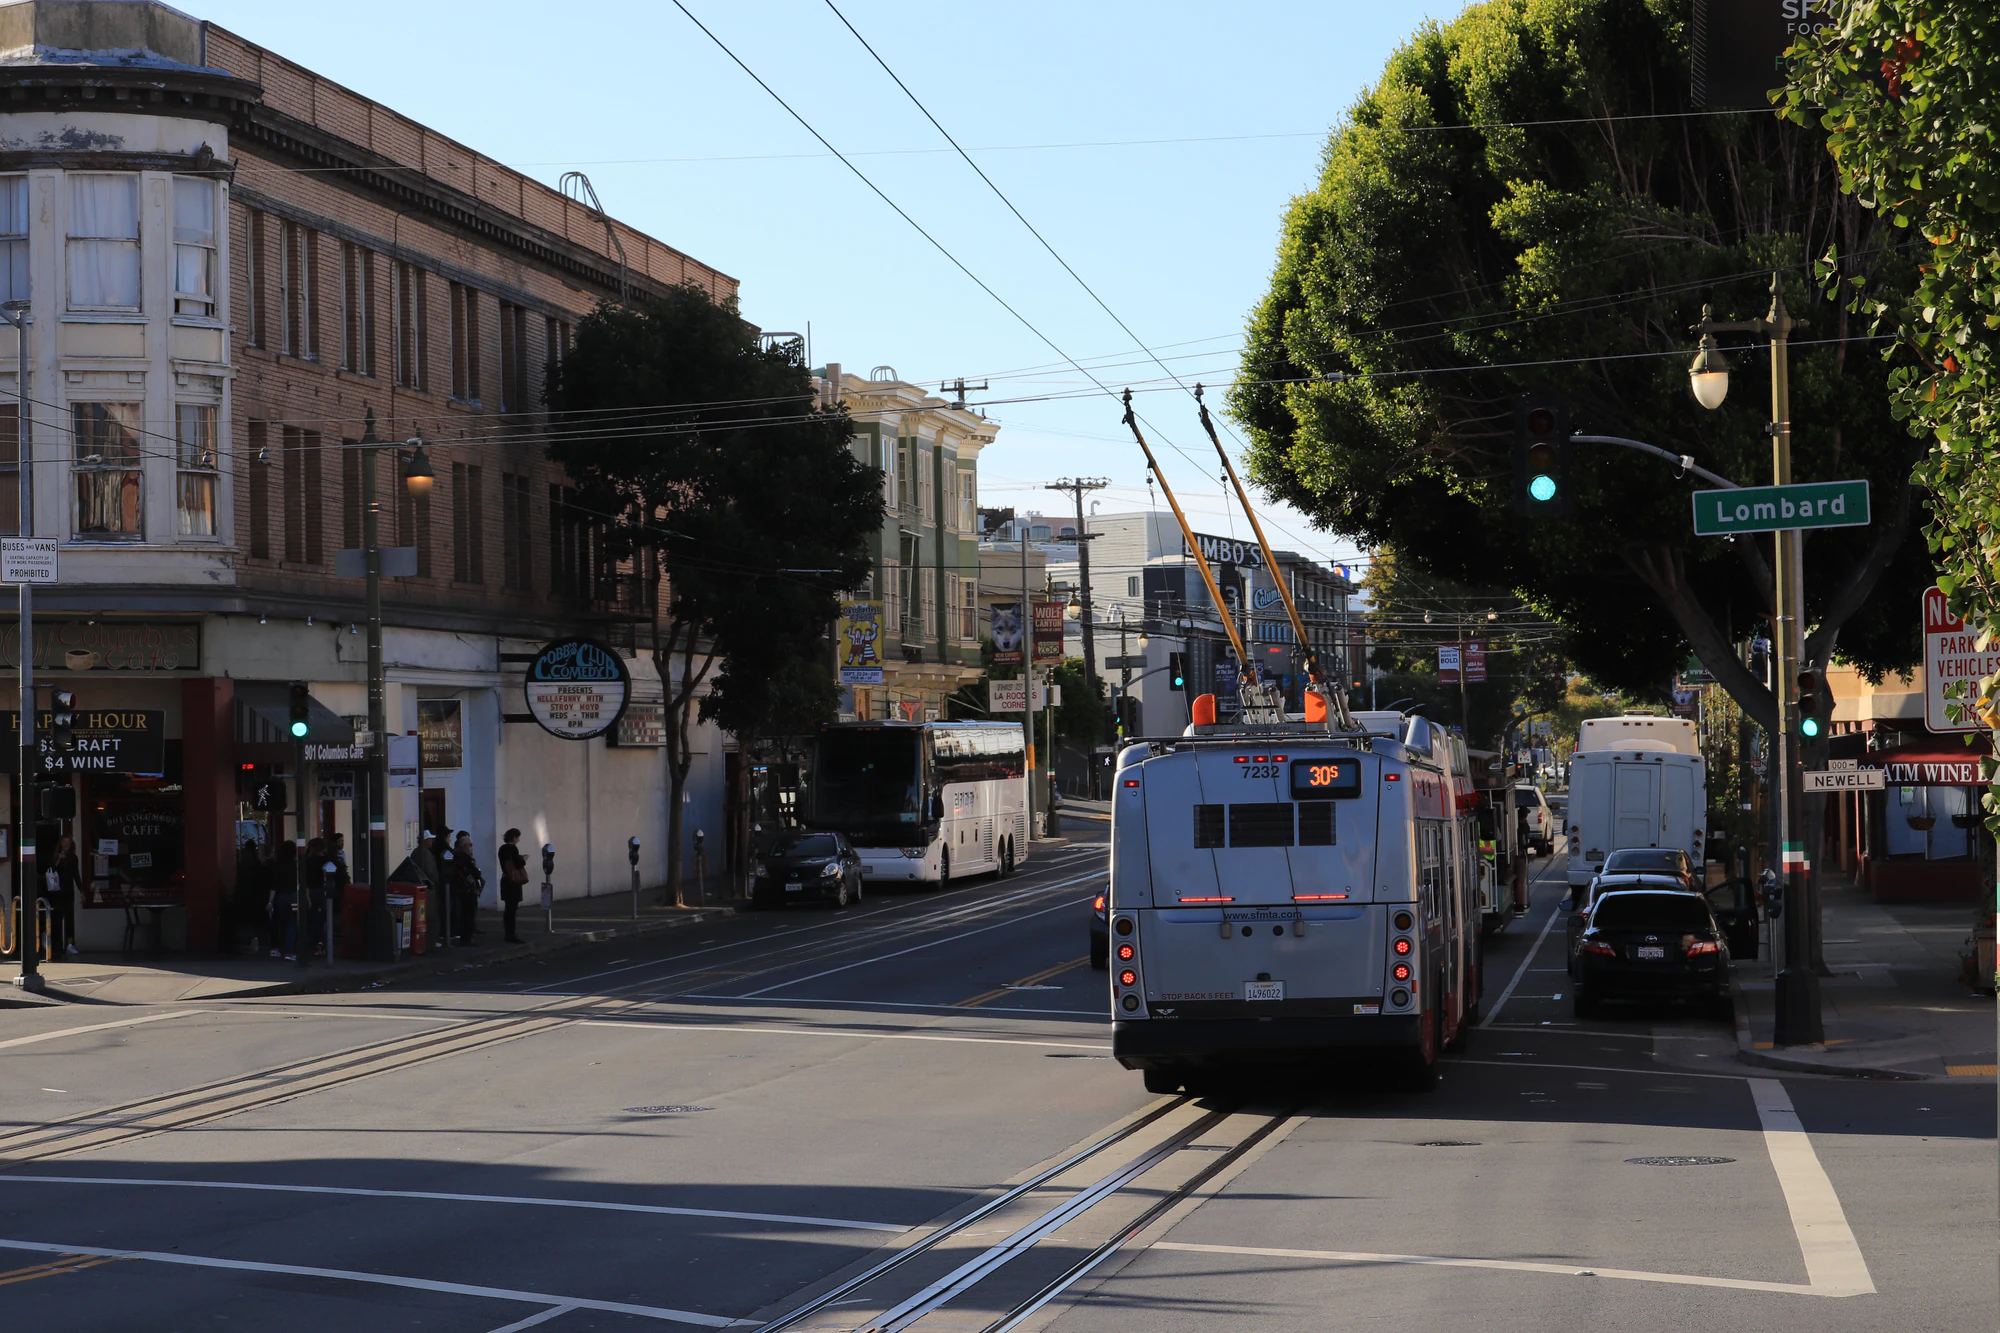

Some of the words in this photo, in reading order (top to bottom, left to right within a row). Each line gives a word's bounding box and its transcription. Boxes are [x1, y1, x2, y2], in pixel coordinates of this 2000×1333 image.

[1717, 494, 1845, 522] Lombard
[3, 542, 24, 551] BUSES
[35, 543, 56, 551] VANS
[10, 569, 49, 578] PROHIBITED
[1035, 607, 1063, 619] WOLF
[1035, 618, 1062, 628] CANYON
[57, 620, 196, 649] Columbus
[1941, 635, 1999, 655] PARKG
[104, 648, 179, 676] Cafe
[535, 642, 578, 680] COBB'S
[576, 643, 620, 680] CLUB
[550, 664, 606, 680] COMEDY
[557, 686, 593, 694] PRESENTS
[997, 683, 1013, 691] THIS
[537, 695, 581, 703] HELLAFUNNY
[994, 692, 1004, 700] LA
[1006, 691, 1037, 700] ROCCS
[1001, 701, 1026, 709] CORNE
[581, 711, 600, 719] THUR
[89, 713, 148, 729] HOUR
[567, 720, 583, 728] 8PM
[440, 729, 457, 739] Live
[66, 738, 122, 752] RAFT
[304, 744, 317, 761] 901
[318, 743, 348, 760] Columbus
[45, 755, 64, 772] $4
[71, 756, 116, 769] WINE
[424, 753, 439, 763] 982
[1831, 762, 1847, 770] 000
[1242, 765, 1280, 779] 7232
[1309, 765, 1339, 786] 30S
[1884, 763, 1920, 782] ATM
[1924, 763, 1973, 782] WINE
[1815, 774, 1875, 787] NEWELL
[319, 786, 352, 798] ATM
[132, 854, 151, 864] OPEN
[1225, 911, 1302, 920] www.sfmta.com
[1161, 993, 1182, 1001] STOP
[1184, 992, 1206, 1000] BACK
[1248, 988, 1281, 999] 1496022
